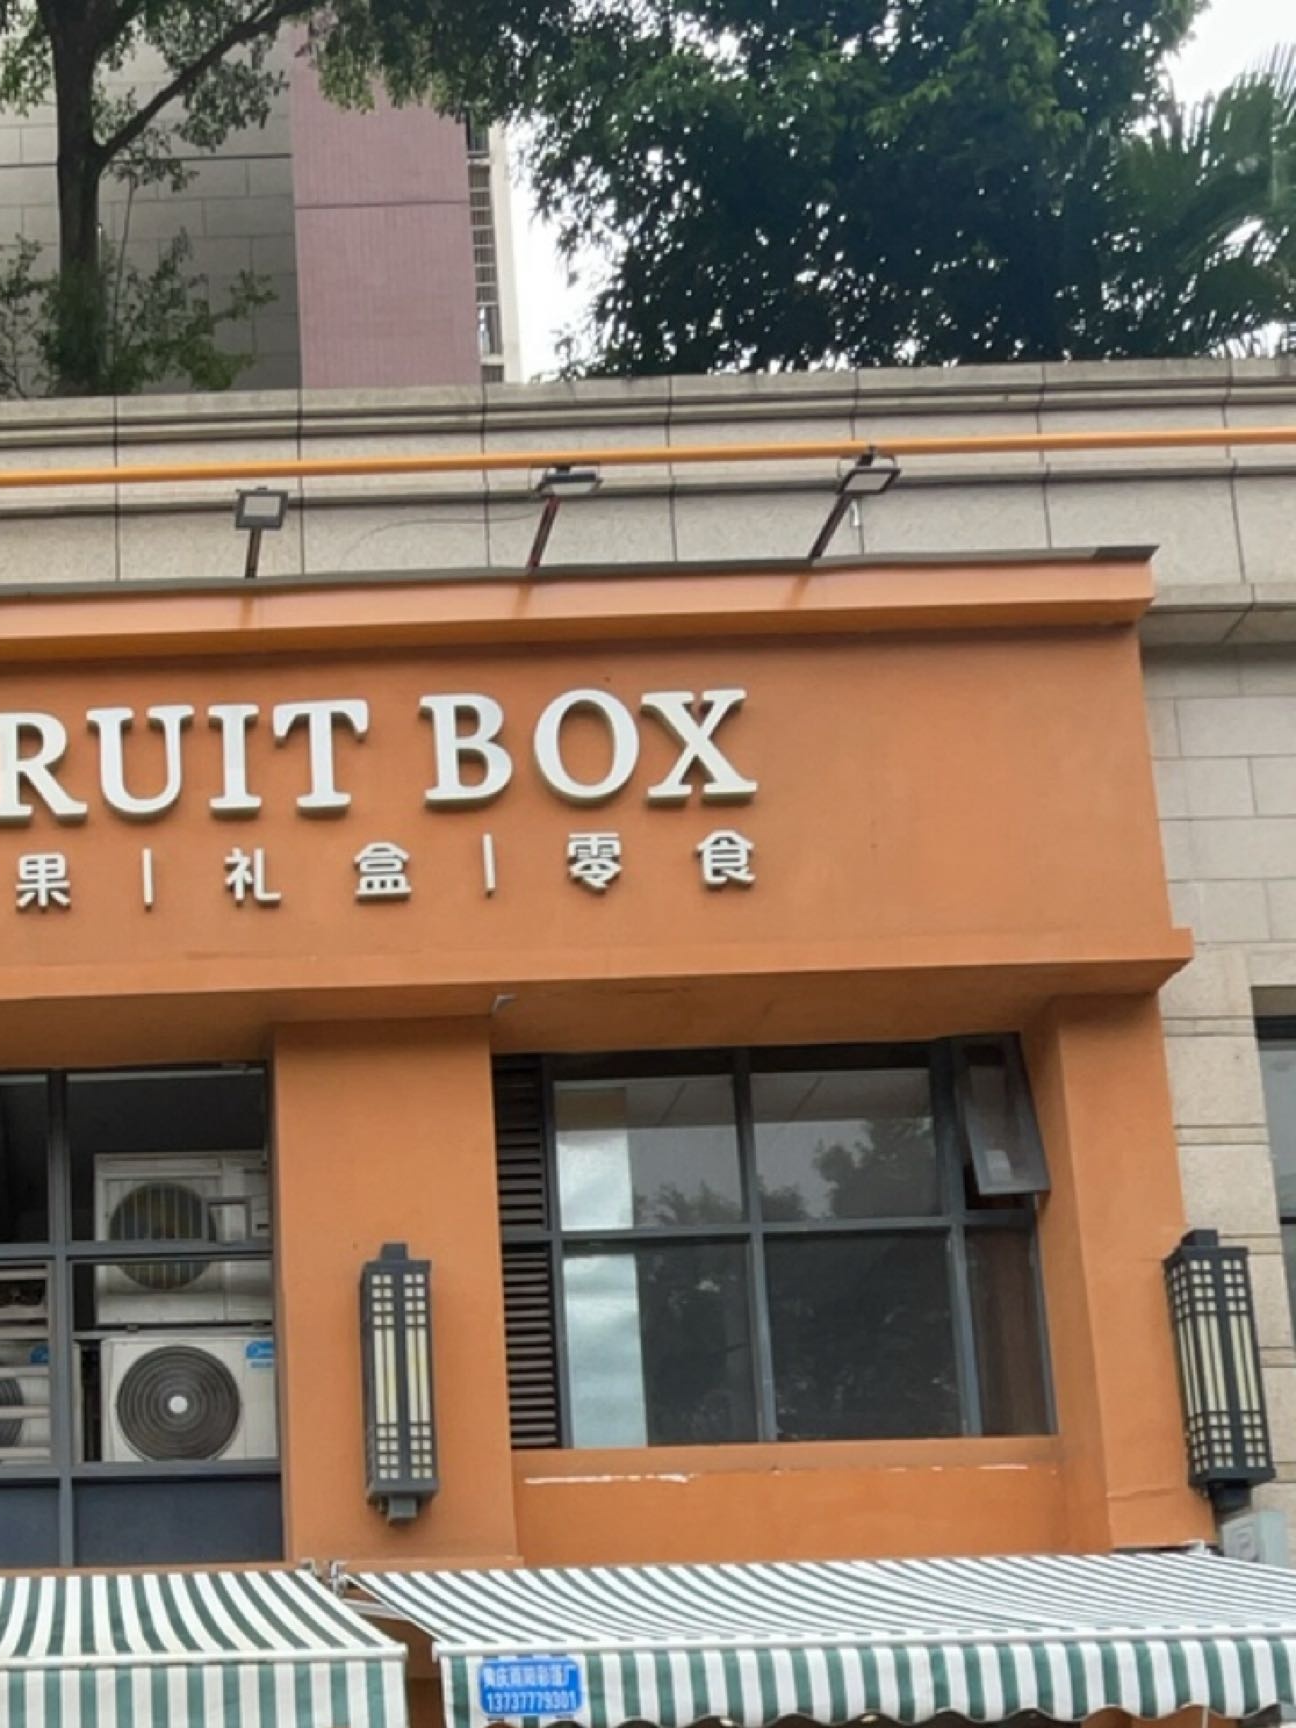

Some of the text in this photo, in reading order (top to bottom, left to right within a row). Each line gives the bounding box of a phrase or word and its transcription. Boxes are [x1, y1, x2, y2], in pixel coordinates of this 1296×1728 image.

[419, 686, 760, 810] BOX
[224, 838, 412, 909] 礼盒
[566, 827, 756, 893] 零食
